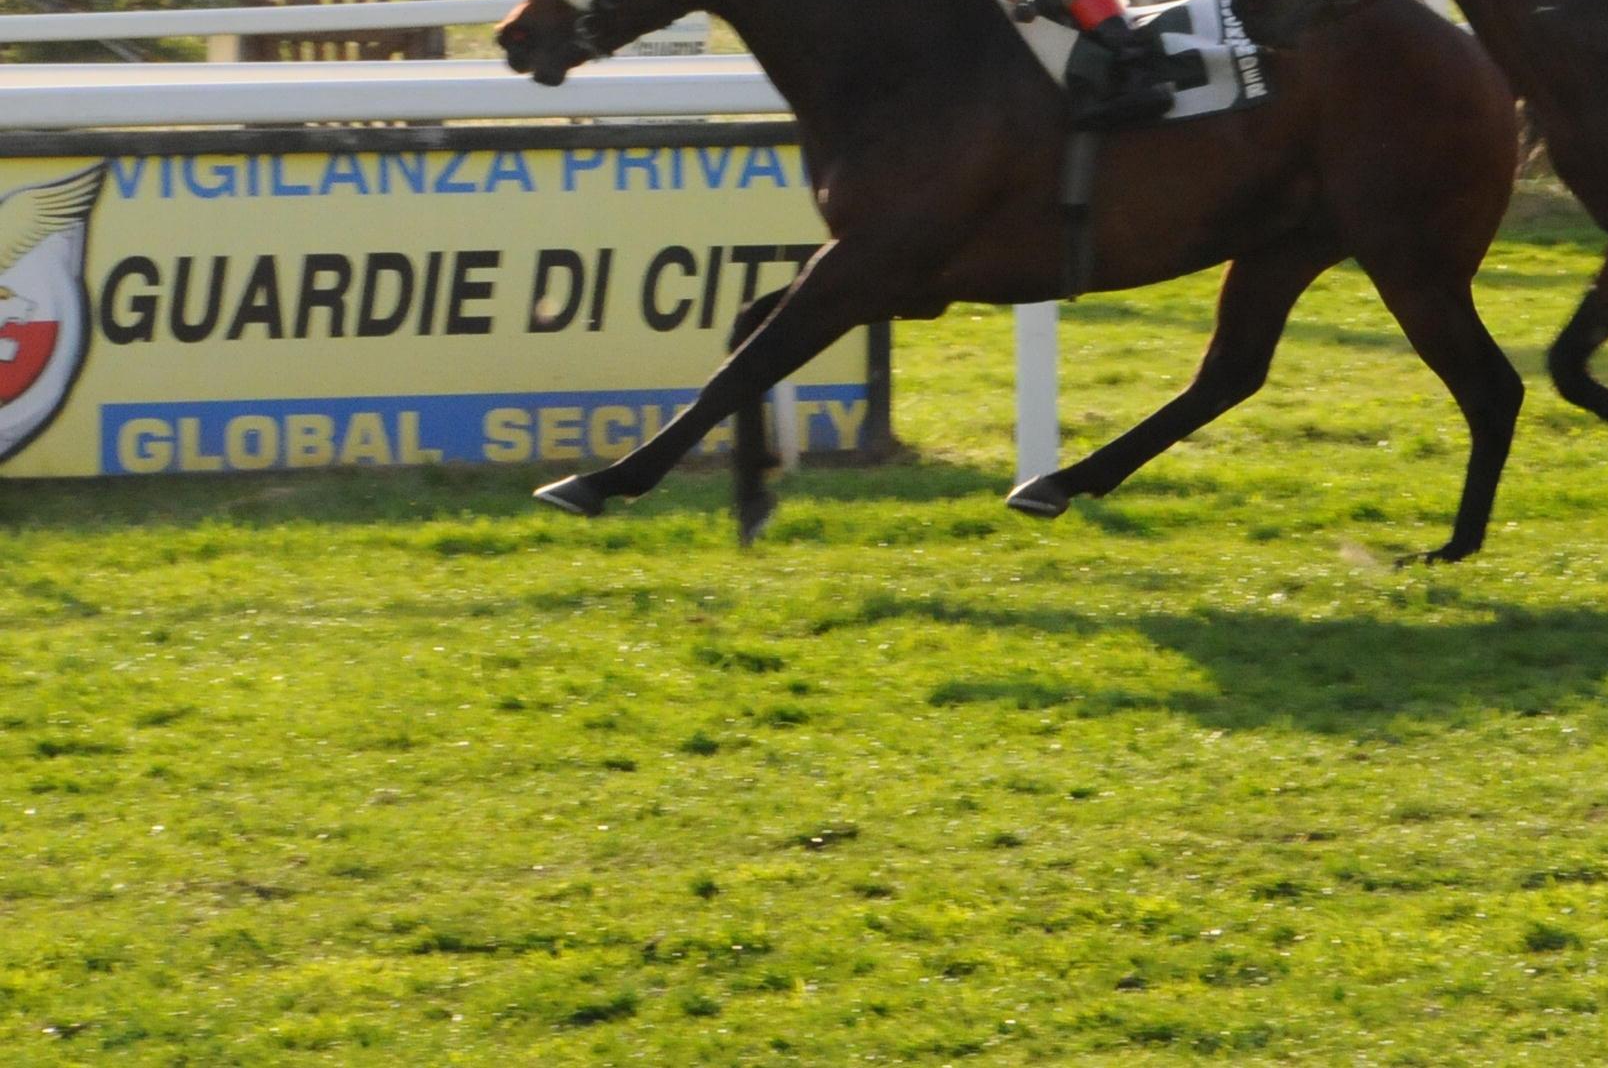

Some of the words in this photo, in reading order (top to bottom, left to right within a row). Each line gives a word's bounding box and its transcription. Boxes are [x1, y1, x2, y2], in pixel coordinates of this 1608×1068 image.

[106, 151, 536, 200] VIGILANZA
[562, 146, 813, 192] PRIVA
[101, 250, 502, 345] GUARDIE
[526, 248, 613, 333] DI
[117, 411, 443, 473] GLOBAL
